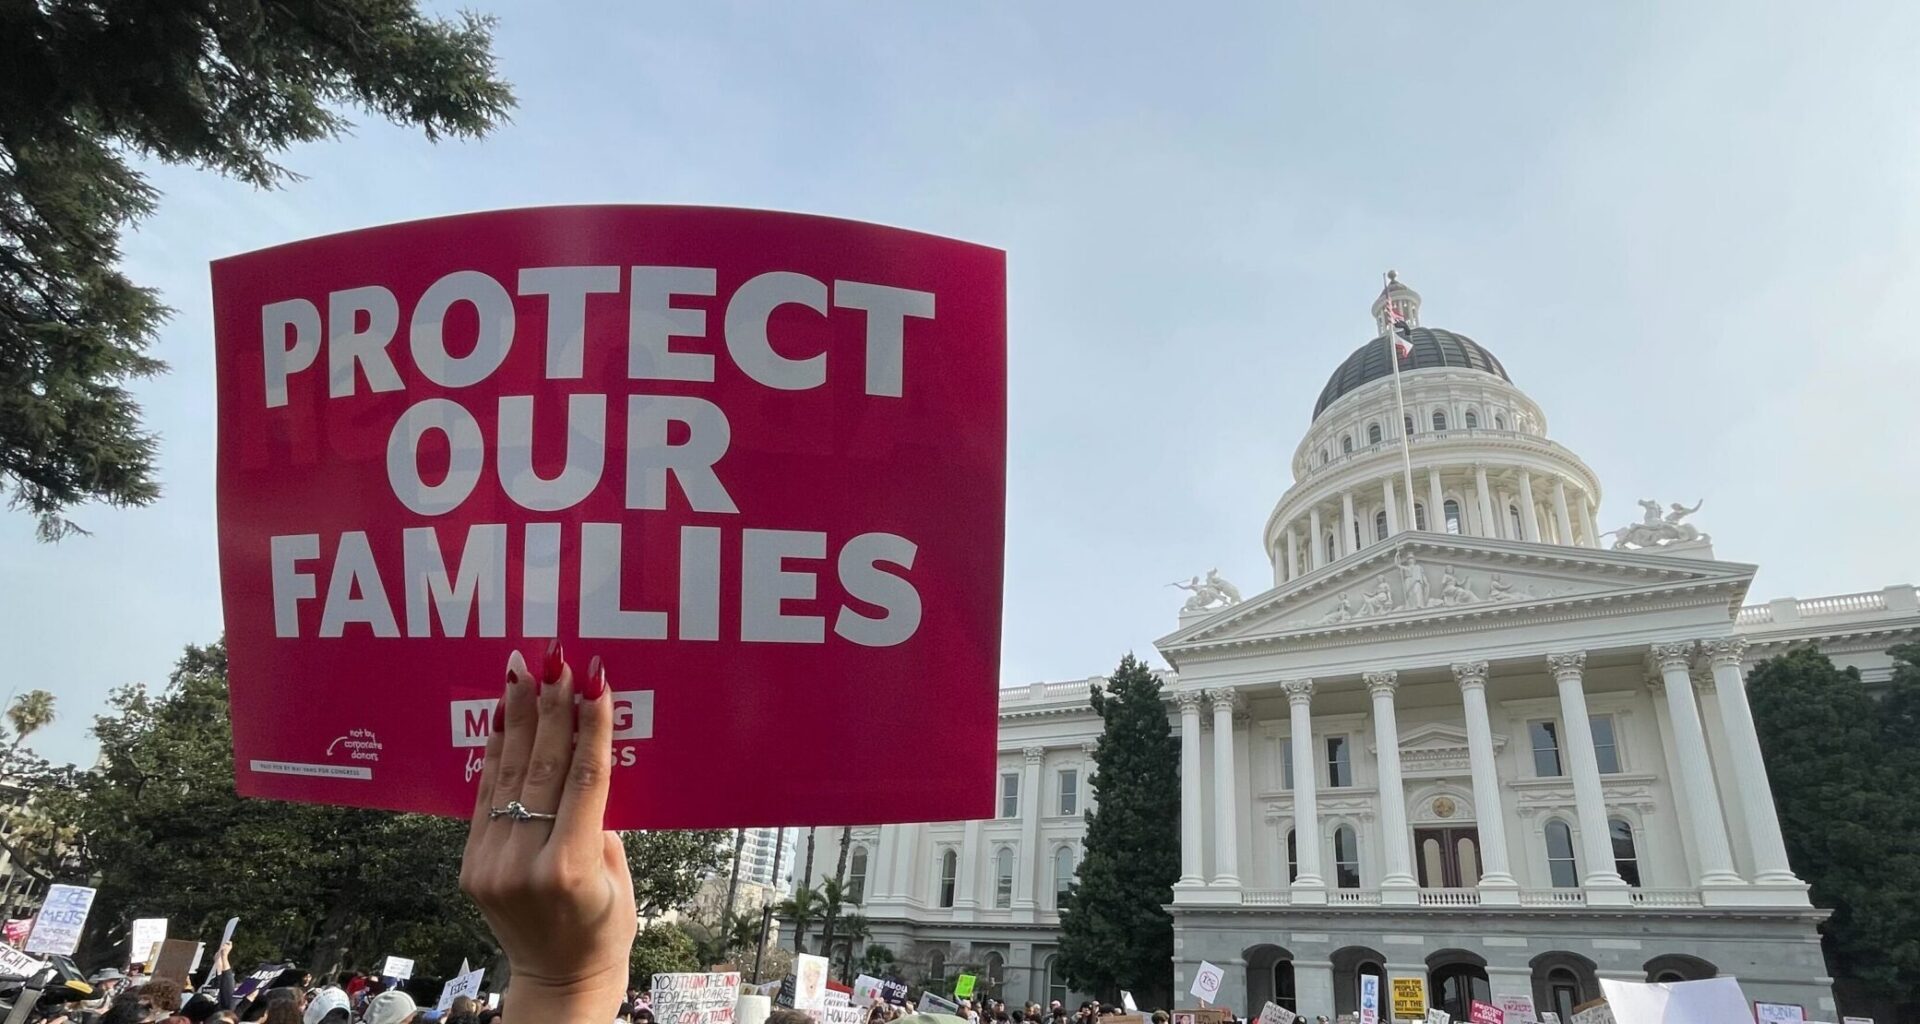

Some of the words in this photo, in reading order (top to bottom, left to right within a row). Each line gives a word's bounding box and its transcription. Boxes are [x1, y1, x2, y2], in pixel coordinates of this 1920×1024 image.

[262, 264, 935, 408] PROTECT
[386, 394, 739, 516] OUR
[270, 522, 922, 646] FAMILIES
[349, 729, 364, 738] not
[365, 728, 376, 743] by
[344, 739, 383, 752] corporate
[351, 748, 380, 761] donors
[330, 768, 361, 777] CONGRESS
[465, 749, 486, 783] fo
[41, 909, 86, 926] MELTS
[654, 975, 677, 991] YOU
[893, 990, 906, 998] ICE
